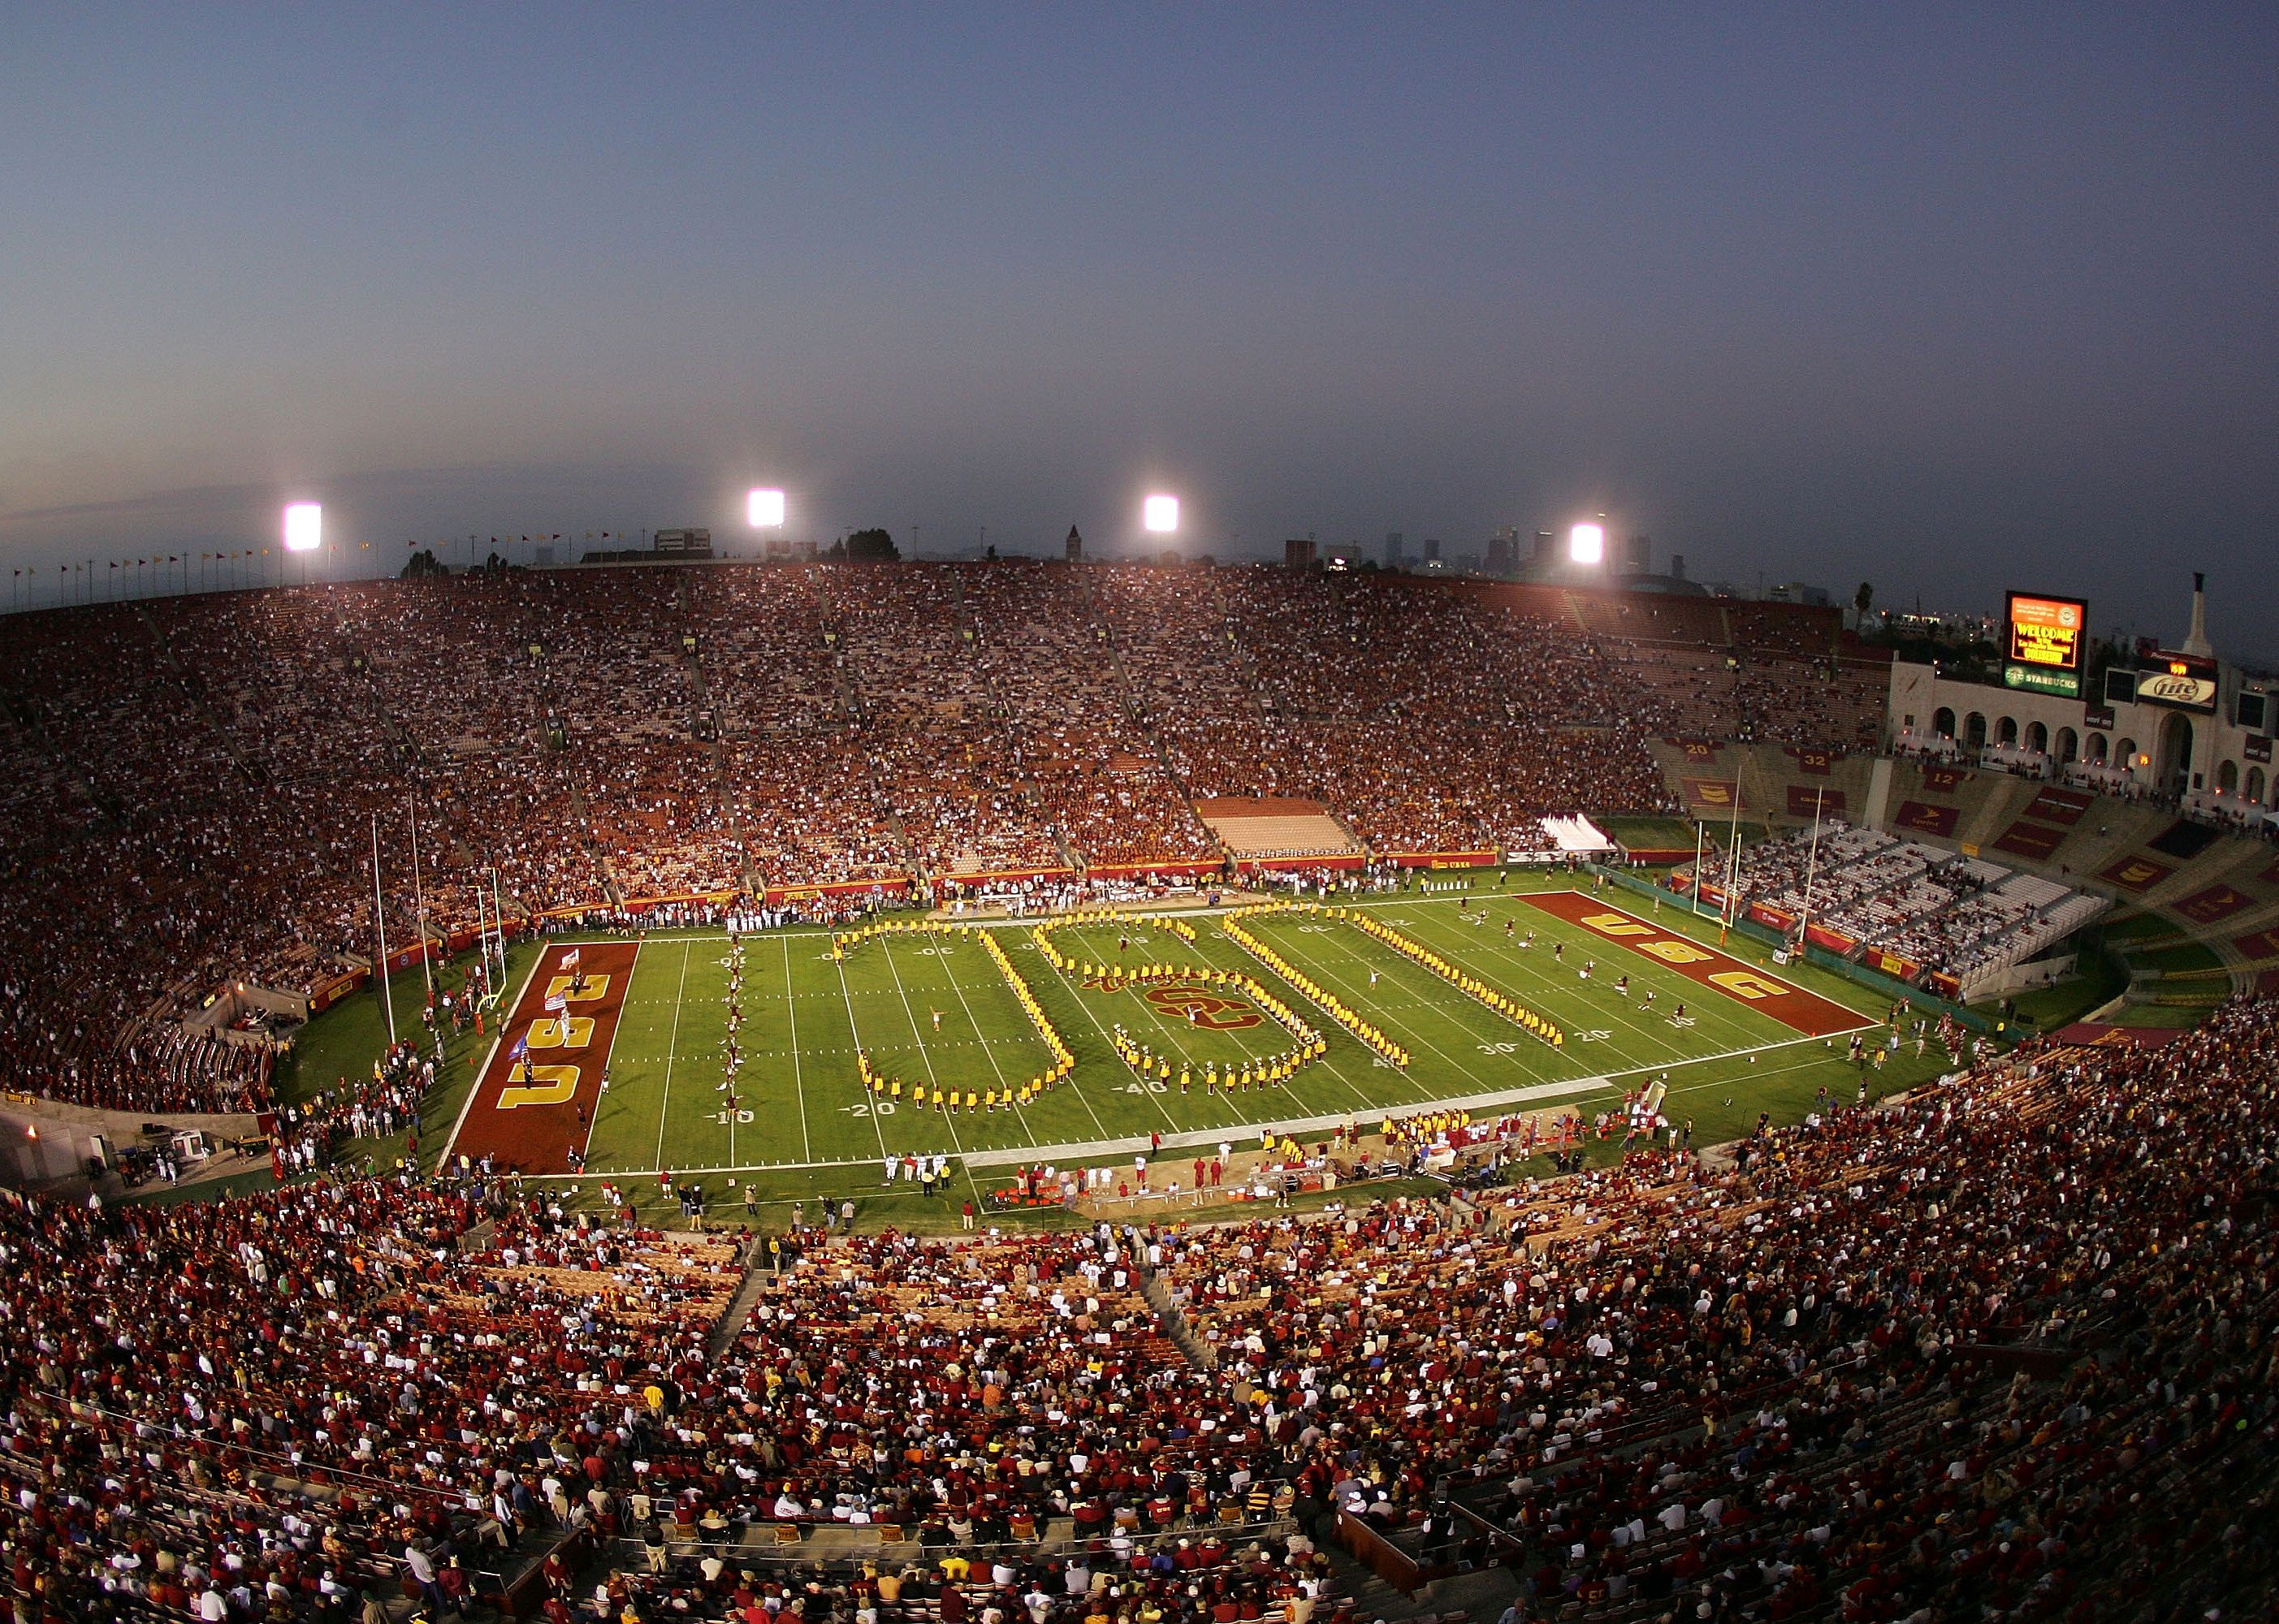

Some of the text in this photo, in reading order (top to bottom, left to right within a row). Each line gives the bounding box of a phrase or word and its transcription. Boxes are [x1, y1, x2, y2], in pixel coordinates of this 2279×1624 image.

[2017, 624, 2074, 642] WELCOME
[2026, 674, 2077, 689] STARBUCKS
[2157, 682, 2198, 696] Lite
[1685, 744, 1708, 755] 20
[1804, 755, 1826, 767] 32
[1933, 772, 1953, 784] 12
[1144, 987, 1265, 1030] SC
[496, 974, 611, 1109] USC
[1574, 1029, 1609, 1043] 20
[1476, 1042, 1512, 1056] 30
[1126, 1081, 1168, 1096] 40
[852, 1102, 896, 1117] 20
[716, 1110, 755, 1125] 10
[99, 1428, 110, 1440] 11
[419, 1427, 426, 1437] 5
[227, 1468, 242, 1484] 55
